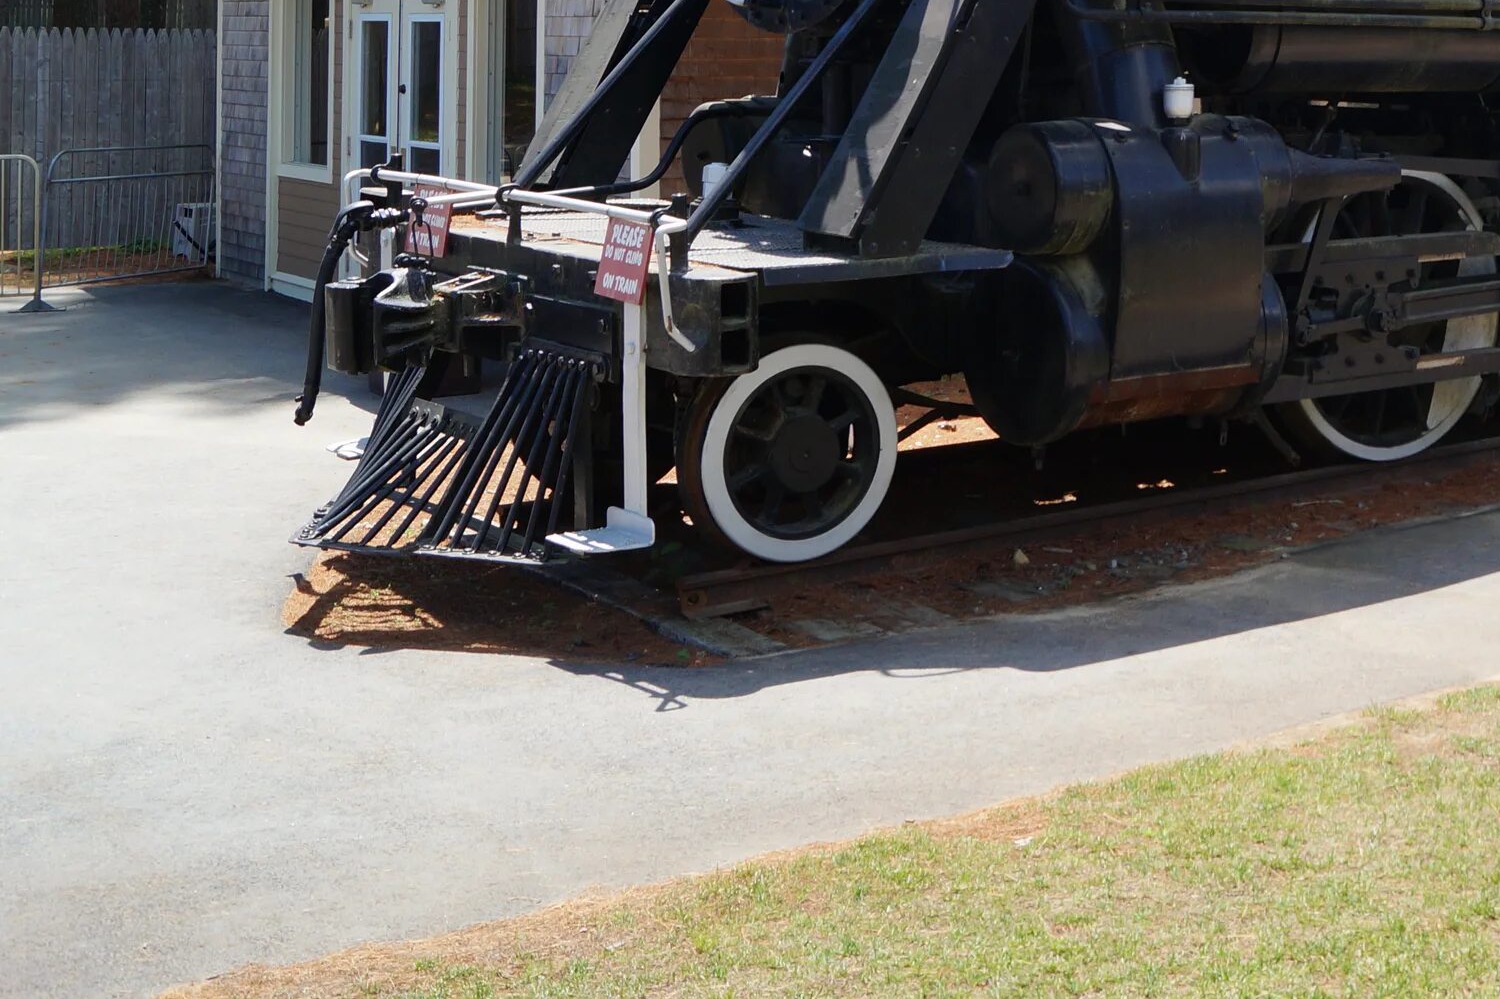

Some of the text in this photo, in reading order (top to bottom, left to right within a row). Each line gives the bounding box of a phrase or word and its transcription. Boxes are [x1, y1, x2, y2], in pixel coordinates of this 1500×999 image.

[611, 224, 646, 248] PLEASE
[604, 244, 614, 259] DO
[613, 247, 627, 262] NOT
[602, 272, 639, 295] ON TRAIN
